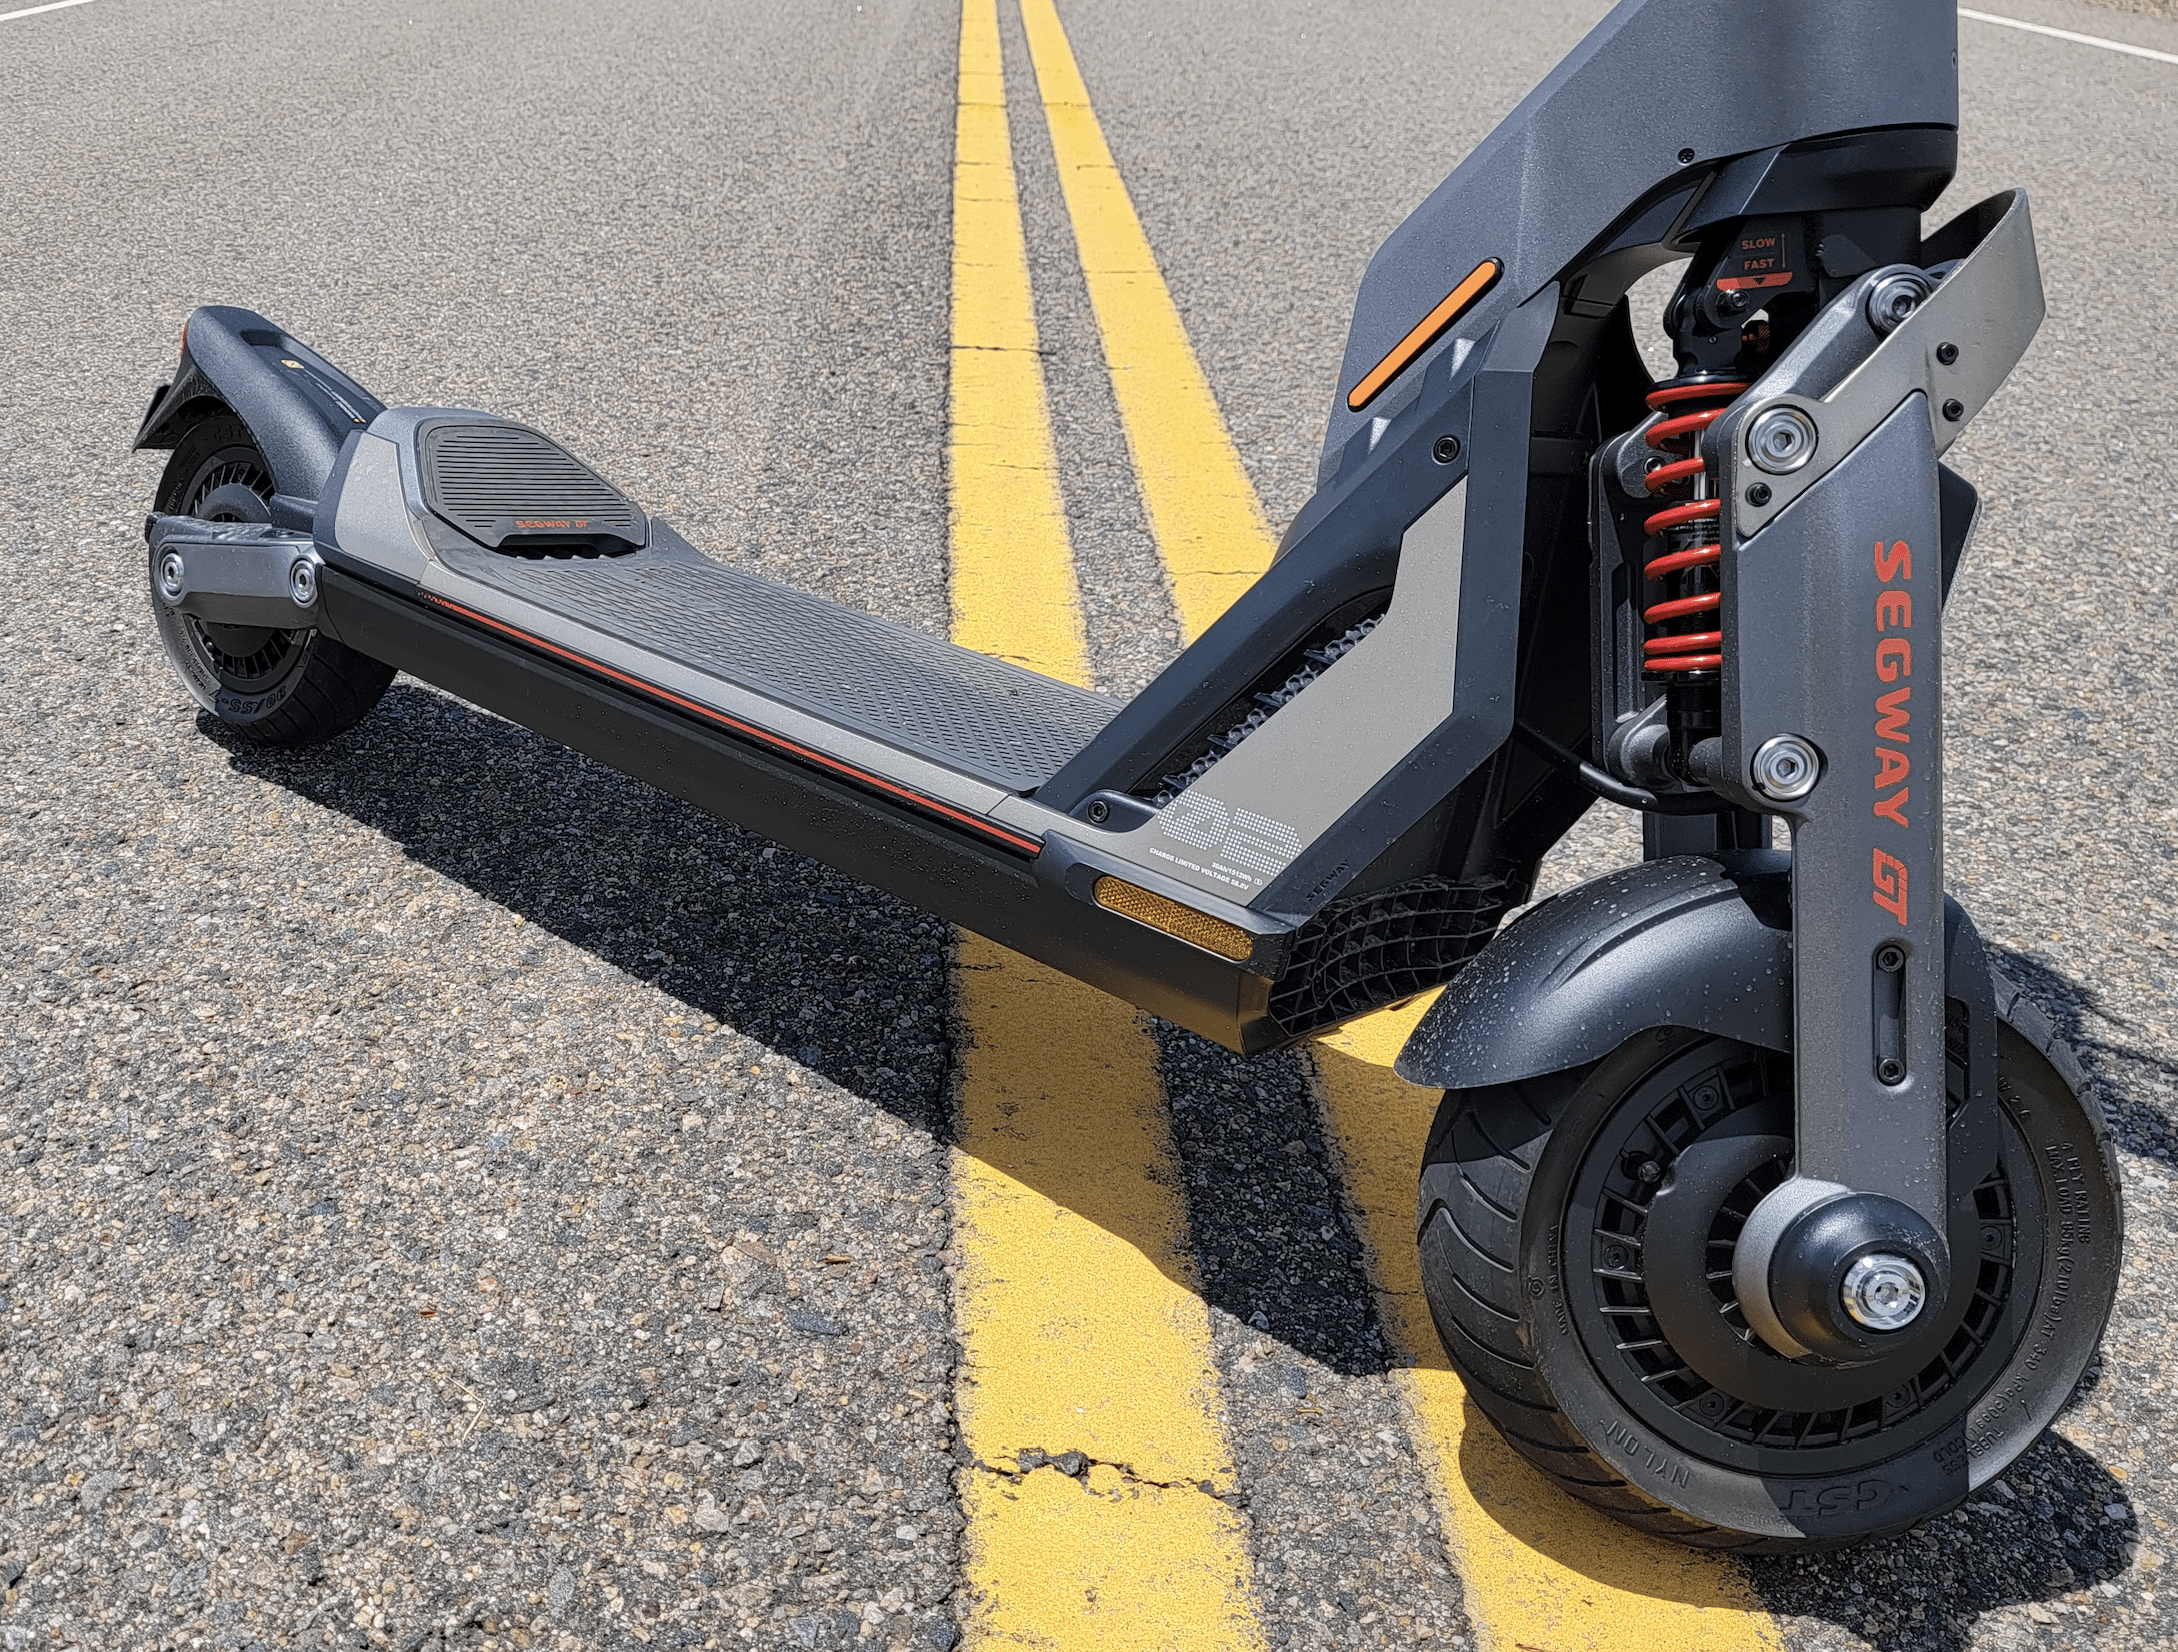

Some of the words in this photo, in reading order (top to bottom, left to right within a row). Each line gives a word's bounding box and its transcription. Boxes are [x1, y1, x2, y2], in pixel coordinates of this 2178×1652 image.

[1741, 237, 1776, 251] SLOW
[1743, 258, 1775, 270] FAST
[1873, 539, 1912, 828] SEGWAY
[1149, 847, 1175, 862] CHARGE
[1174, 857, 1200, 871] LIMITED
[1201, 867, 1230, 883] VOLTAGE
[1305, 858, 1349, 902] SEGWAY
[1872, 847, 1908, 927] GT
[2073, 1190, 2091, 1244] RATING
[1605, 1419, 1690, 1490] NYLON
